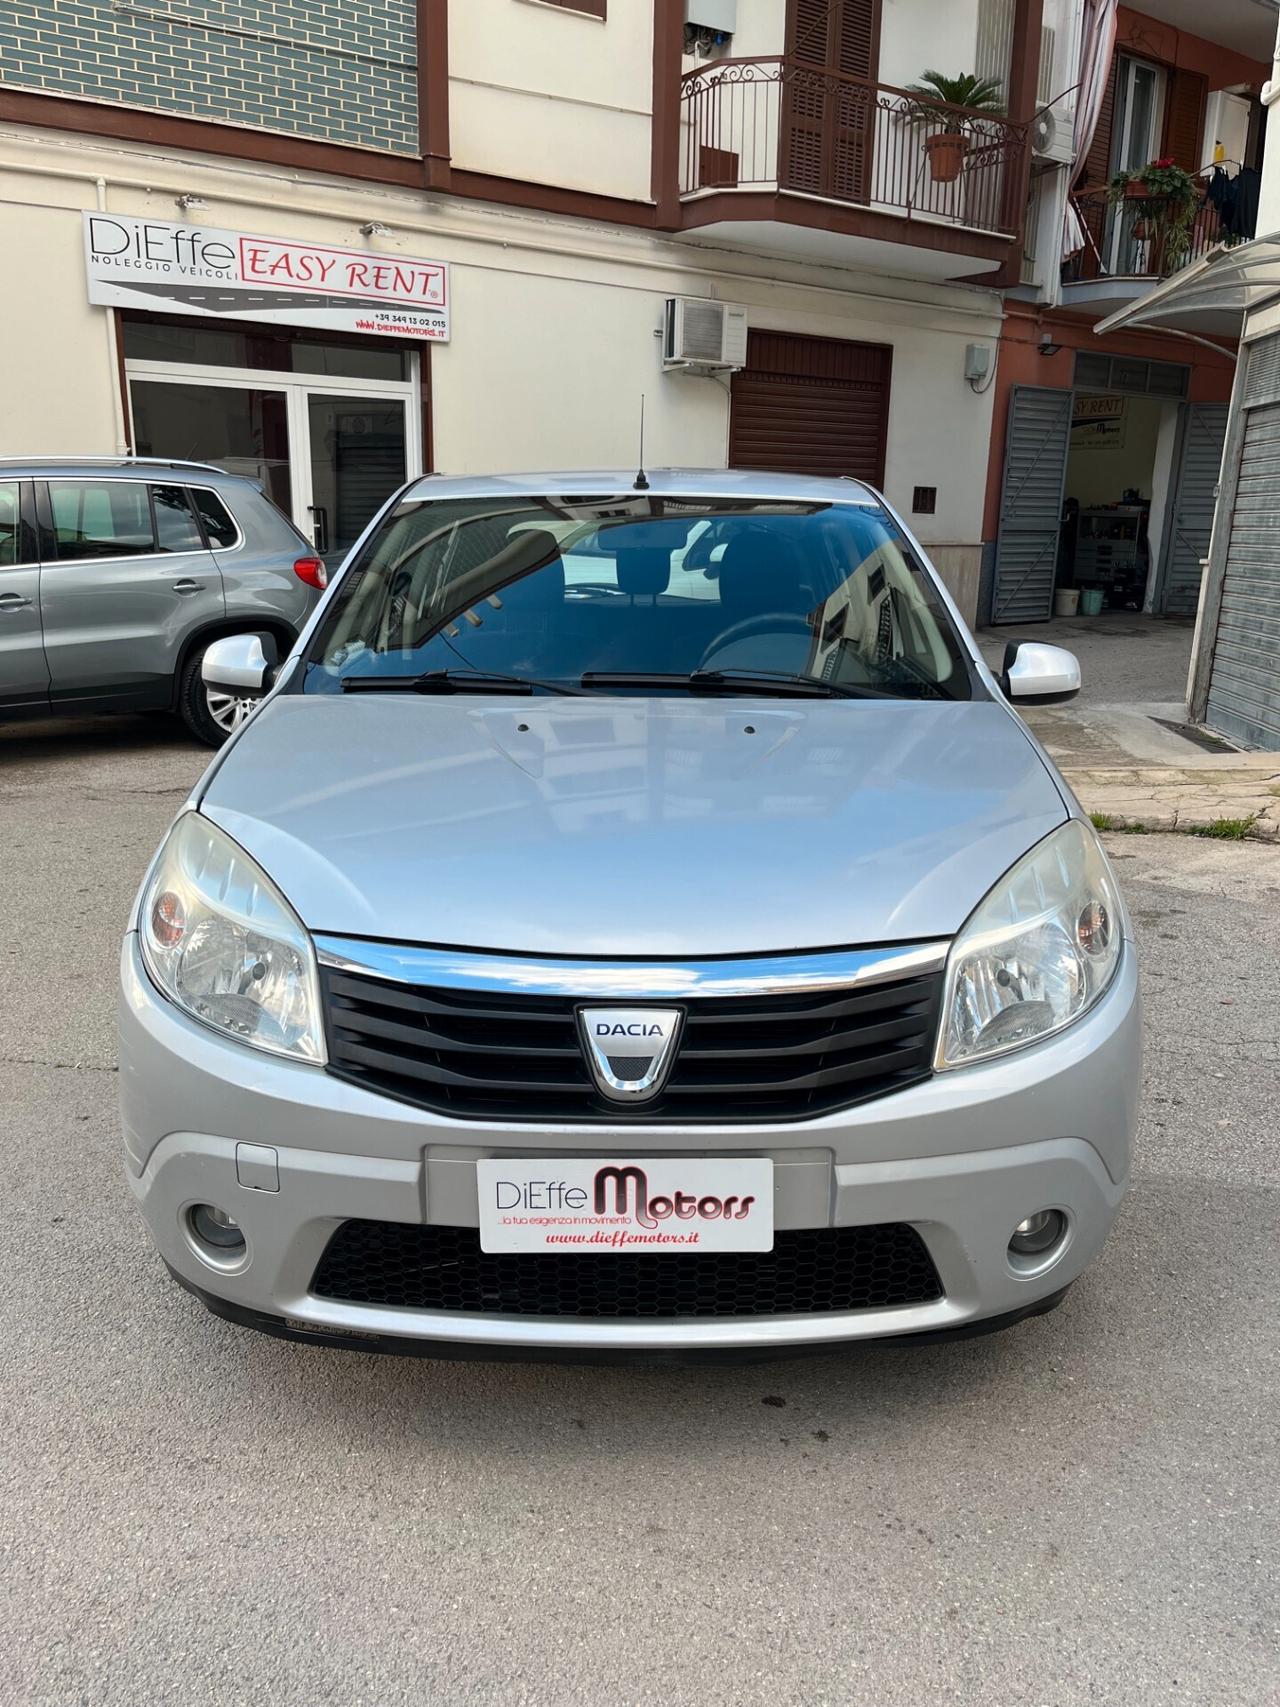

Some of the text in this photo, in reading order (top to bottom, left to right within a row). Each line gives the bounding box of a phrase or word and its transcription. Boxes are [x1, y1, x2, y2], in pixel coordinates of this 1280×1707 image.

[89, 217, 236, 270] DiEffe
[91, 255, 238, 280] NOLEGGIO VEICOLI
[248, 248, 336, 283] EASY
[375, 313, 446, 328] +39 349 13 02 015
[596, 1023, 664, 1036] DACIA
[496, 1165, 756, 1230] DiEffe Motors
[513, 1216, 528, 1225] tua
[529, 1216, 573, 1226] esigenza
[573, 1216, 580, 1225] in
[581, 1216, 632, 1225] movimento
[545, 1230, 700, 1247] www.dieffemotors.it
